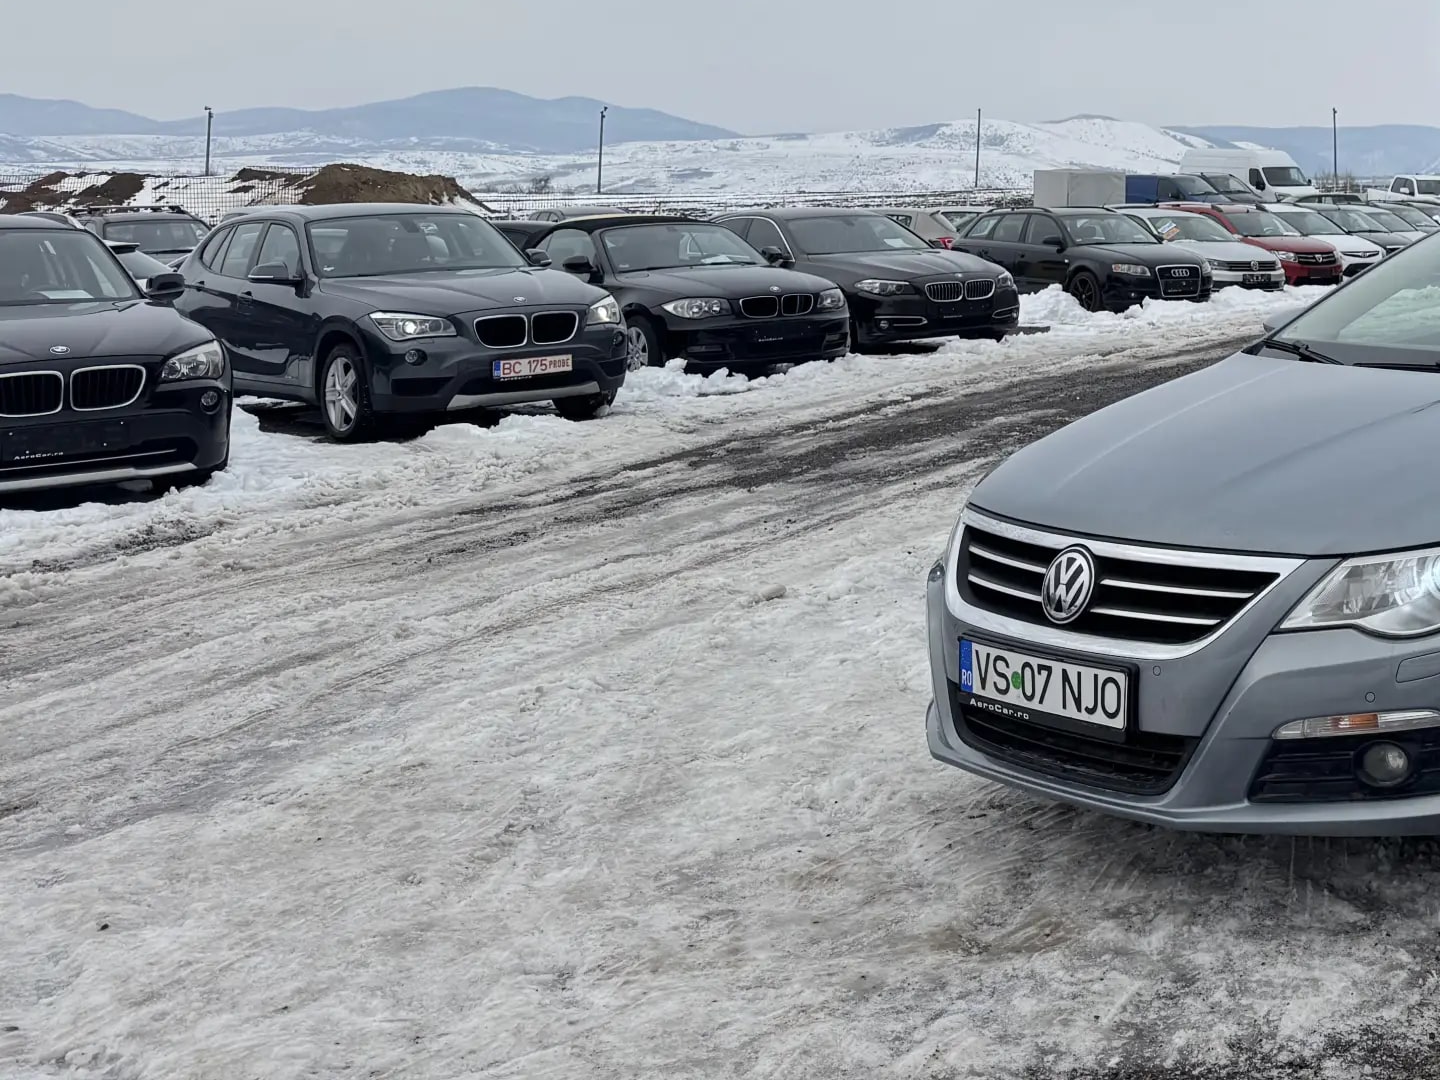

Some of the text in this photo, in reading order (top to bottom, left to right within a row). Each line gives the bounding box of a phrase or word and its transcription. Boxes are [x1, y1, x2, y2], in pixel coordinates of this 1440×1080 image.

[502, 361, 522, 375] BC
[527, 359, 548, 373] 175
[961, 670, 972, 685] RO
[975, 649, 1122, 720] VS 07 NJO
[969, 697, 1030, 720] AeroCar.ro
